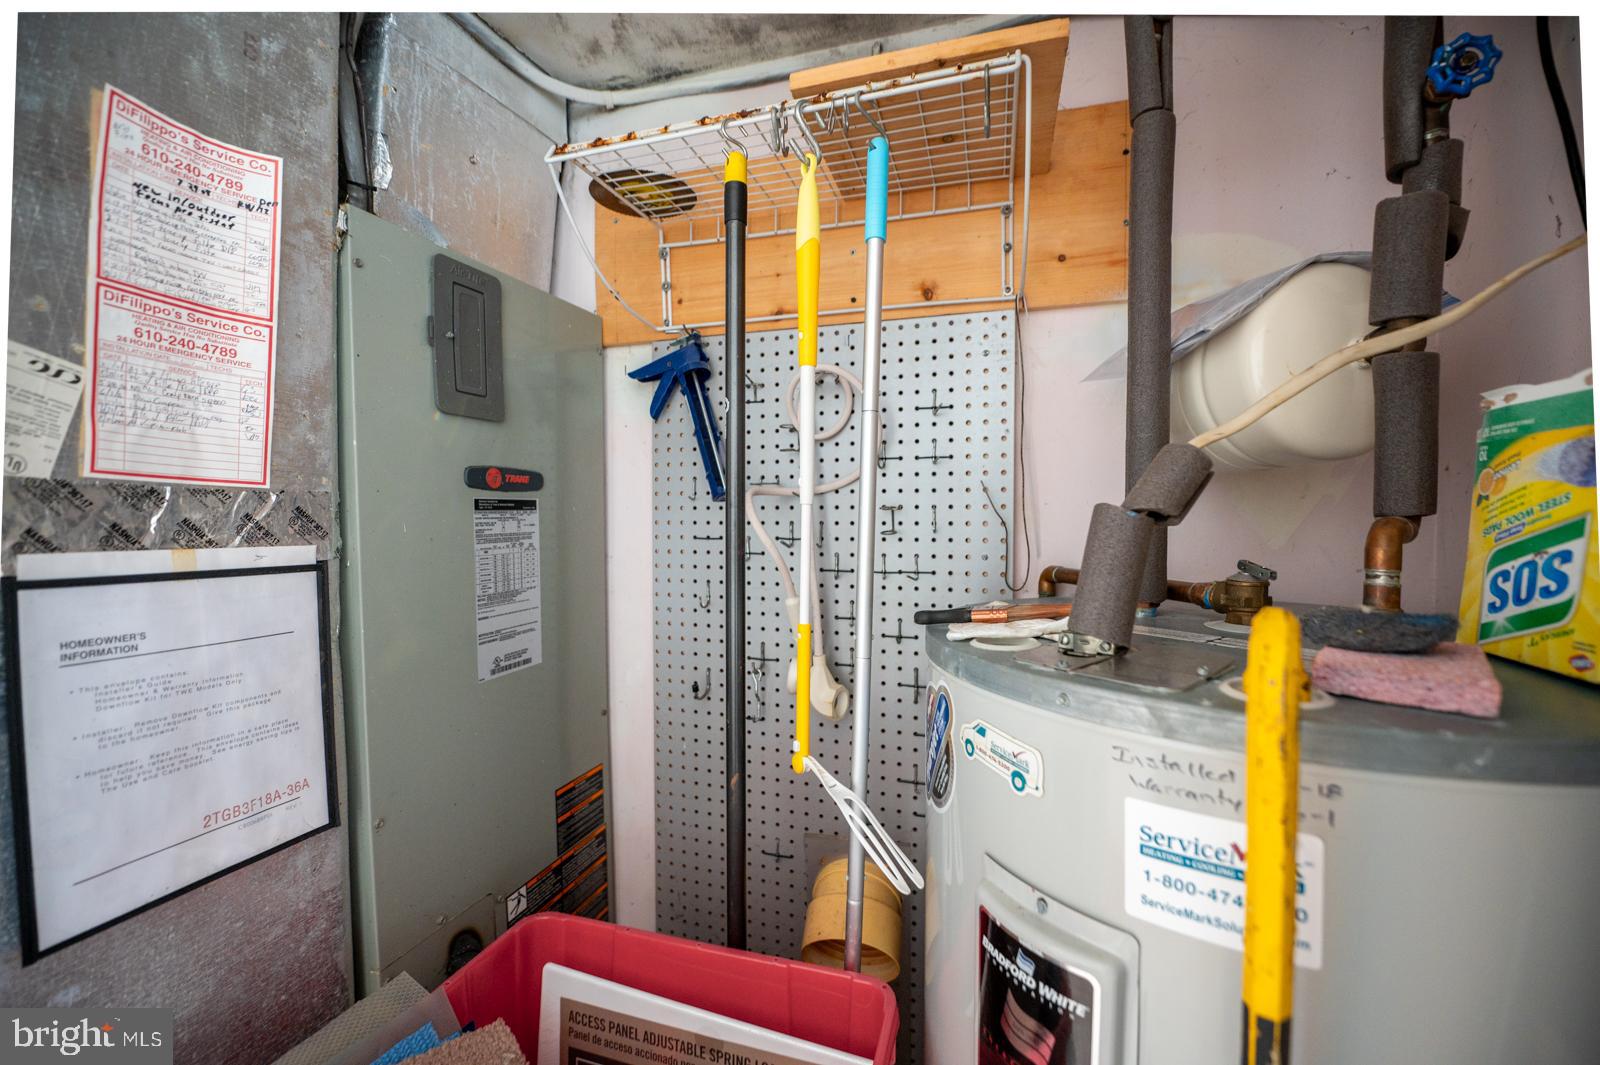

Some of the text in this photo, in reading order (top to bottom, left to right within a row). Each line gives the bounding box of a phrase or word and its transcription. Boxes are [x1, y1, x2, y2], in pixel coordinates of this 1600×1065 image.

[115, 98, 189, 144] DiFilippo's
[192, 140, 245, 167] Service
[249, 159, 272, 173] Co.
[141, 143, 244, 192] 610-240-4789
[103, 289, 266, 338] DiFilippo's Service Co.
[116, 335, 252, 369] 24 HOUR EMERGENCY SERVICE
[134, 326, 238, 359] 610-240-4789
[192, 327, 240, 344] CONDITIONING
[1487, 549, 1573, 615] SOS
[60, 632, 147, 650] HOMEOWNER'S
[60, 644, 139, 662] INFORMATION
[1112, 745, 1235, 783] Installed
[203, 778, 310, 829] 2TGB3F18A-36A
[1129, 774, 1243, 813] Warranty
[982, 934, 1089, 1019] BRADFORD WHITE
[568, 1010, 751, 1065] ACCESS PANEL ADJUSTABLE SPRING
[568, 1027, 591, 1042] Panel
[592, 1032, 602, 1046] de
[603, 1038, 633, 1055] acceso
[634, 1046, 678, 1065] accionado
